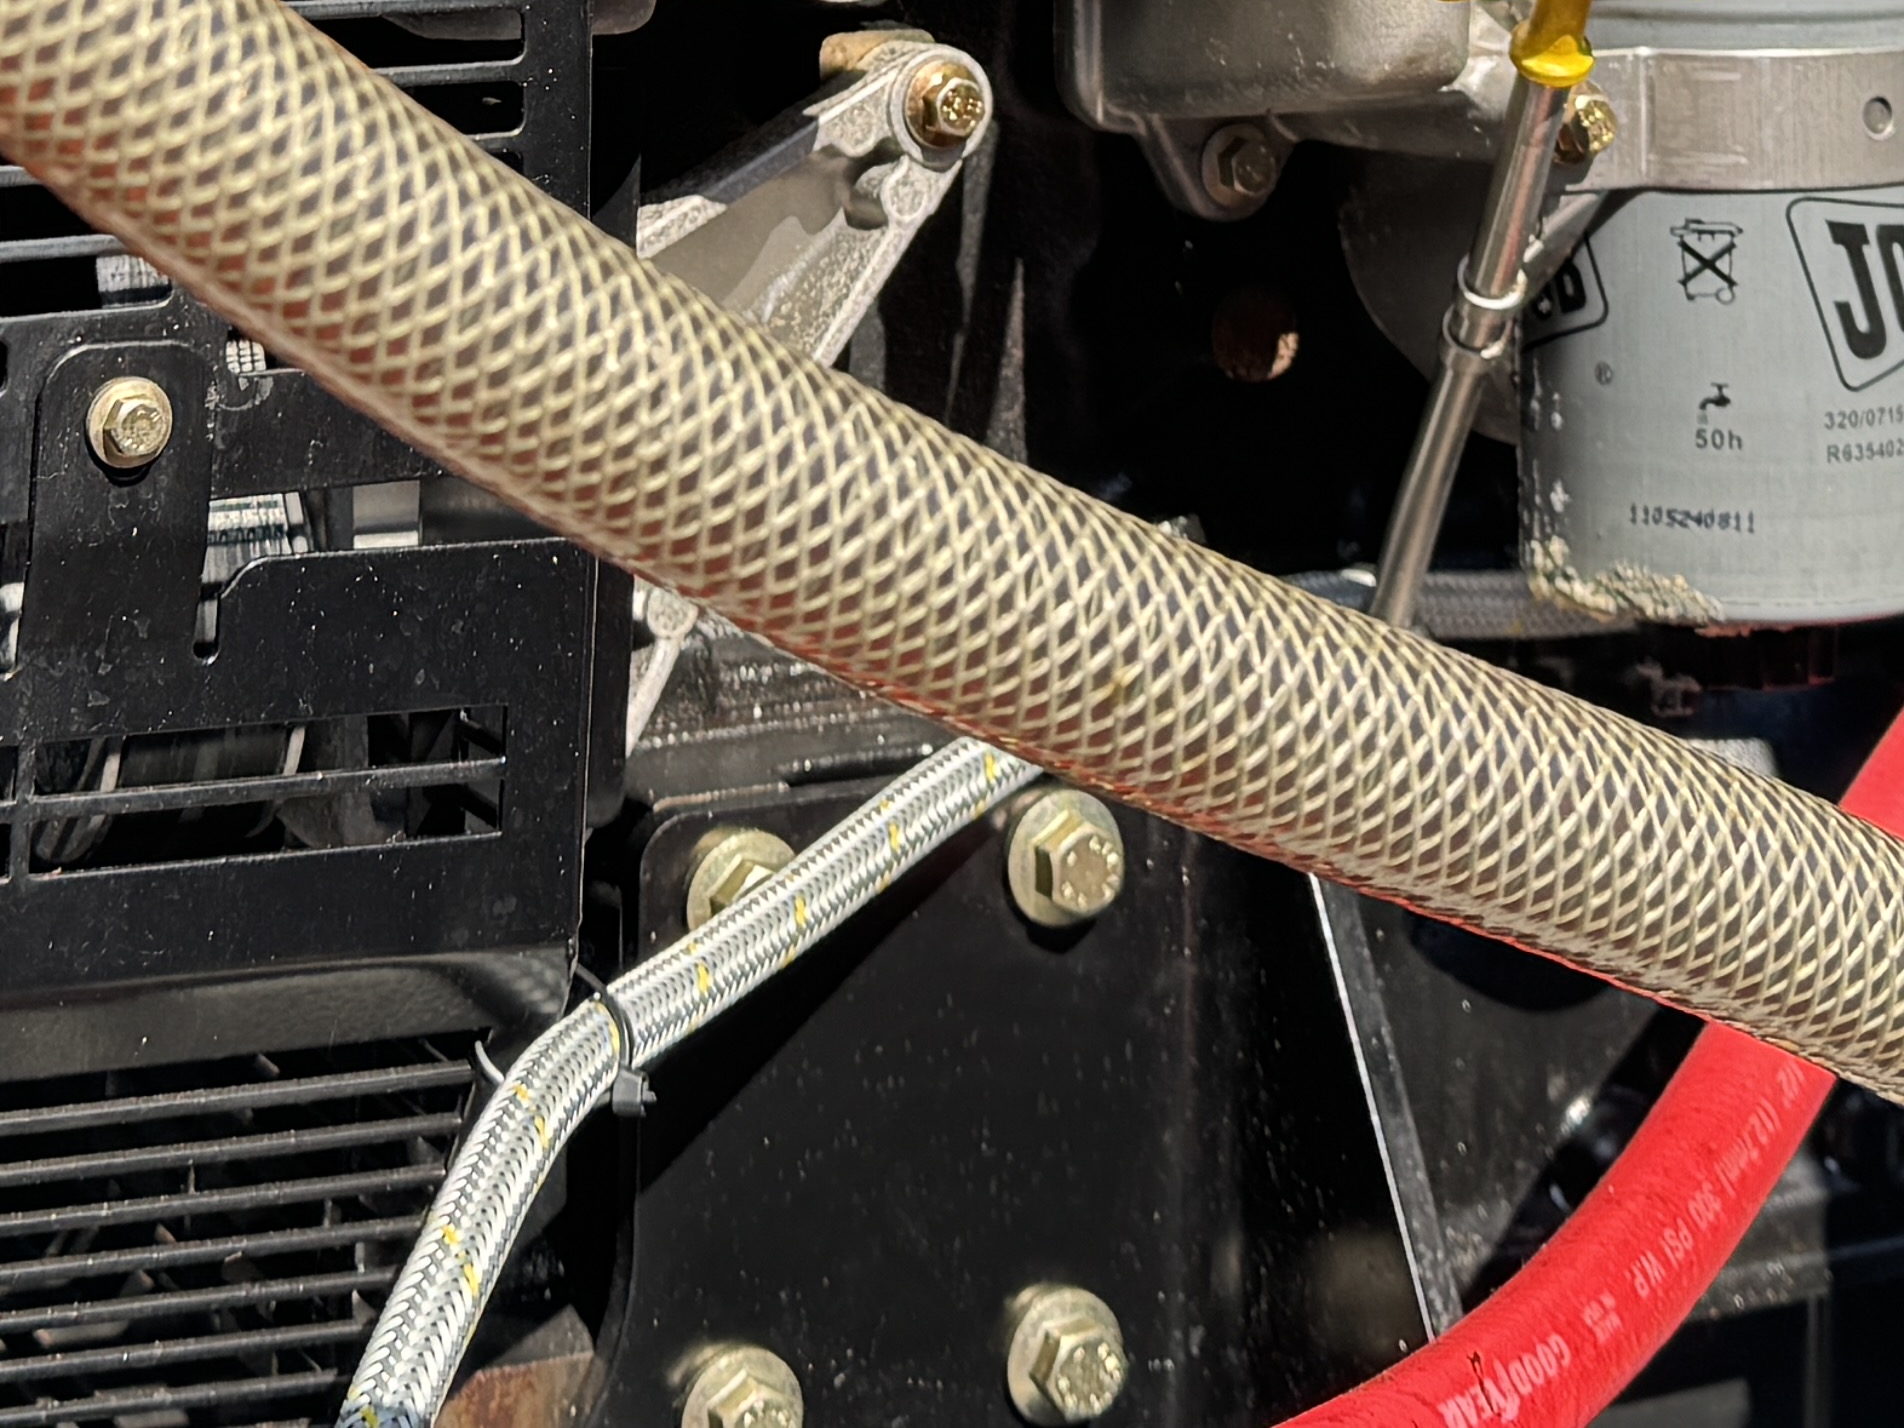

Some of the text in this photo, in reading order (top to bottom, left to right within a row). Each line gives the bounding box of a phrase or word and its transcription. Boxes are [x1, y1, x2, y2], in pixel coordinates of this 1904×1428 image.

[1695, 428, 1742, 450] 50h
[1688, 1180, 1723, 1231] 300
[1659, 1218, 1694, 1270] PSI
